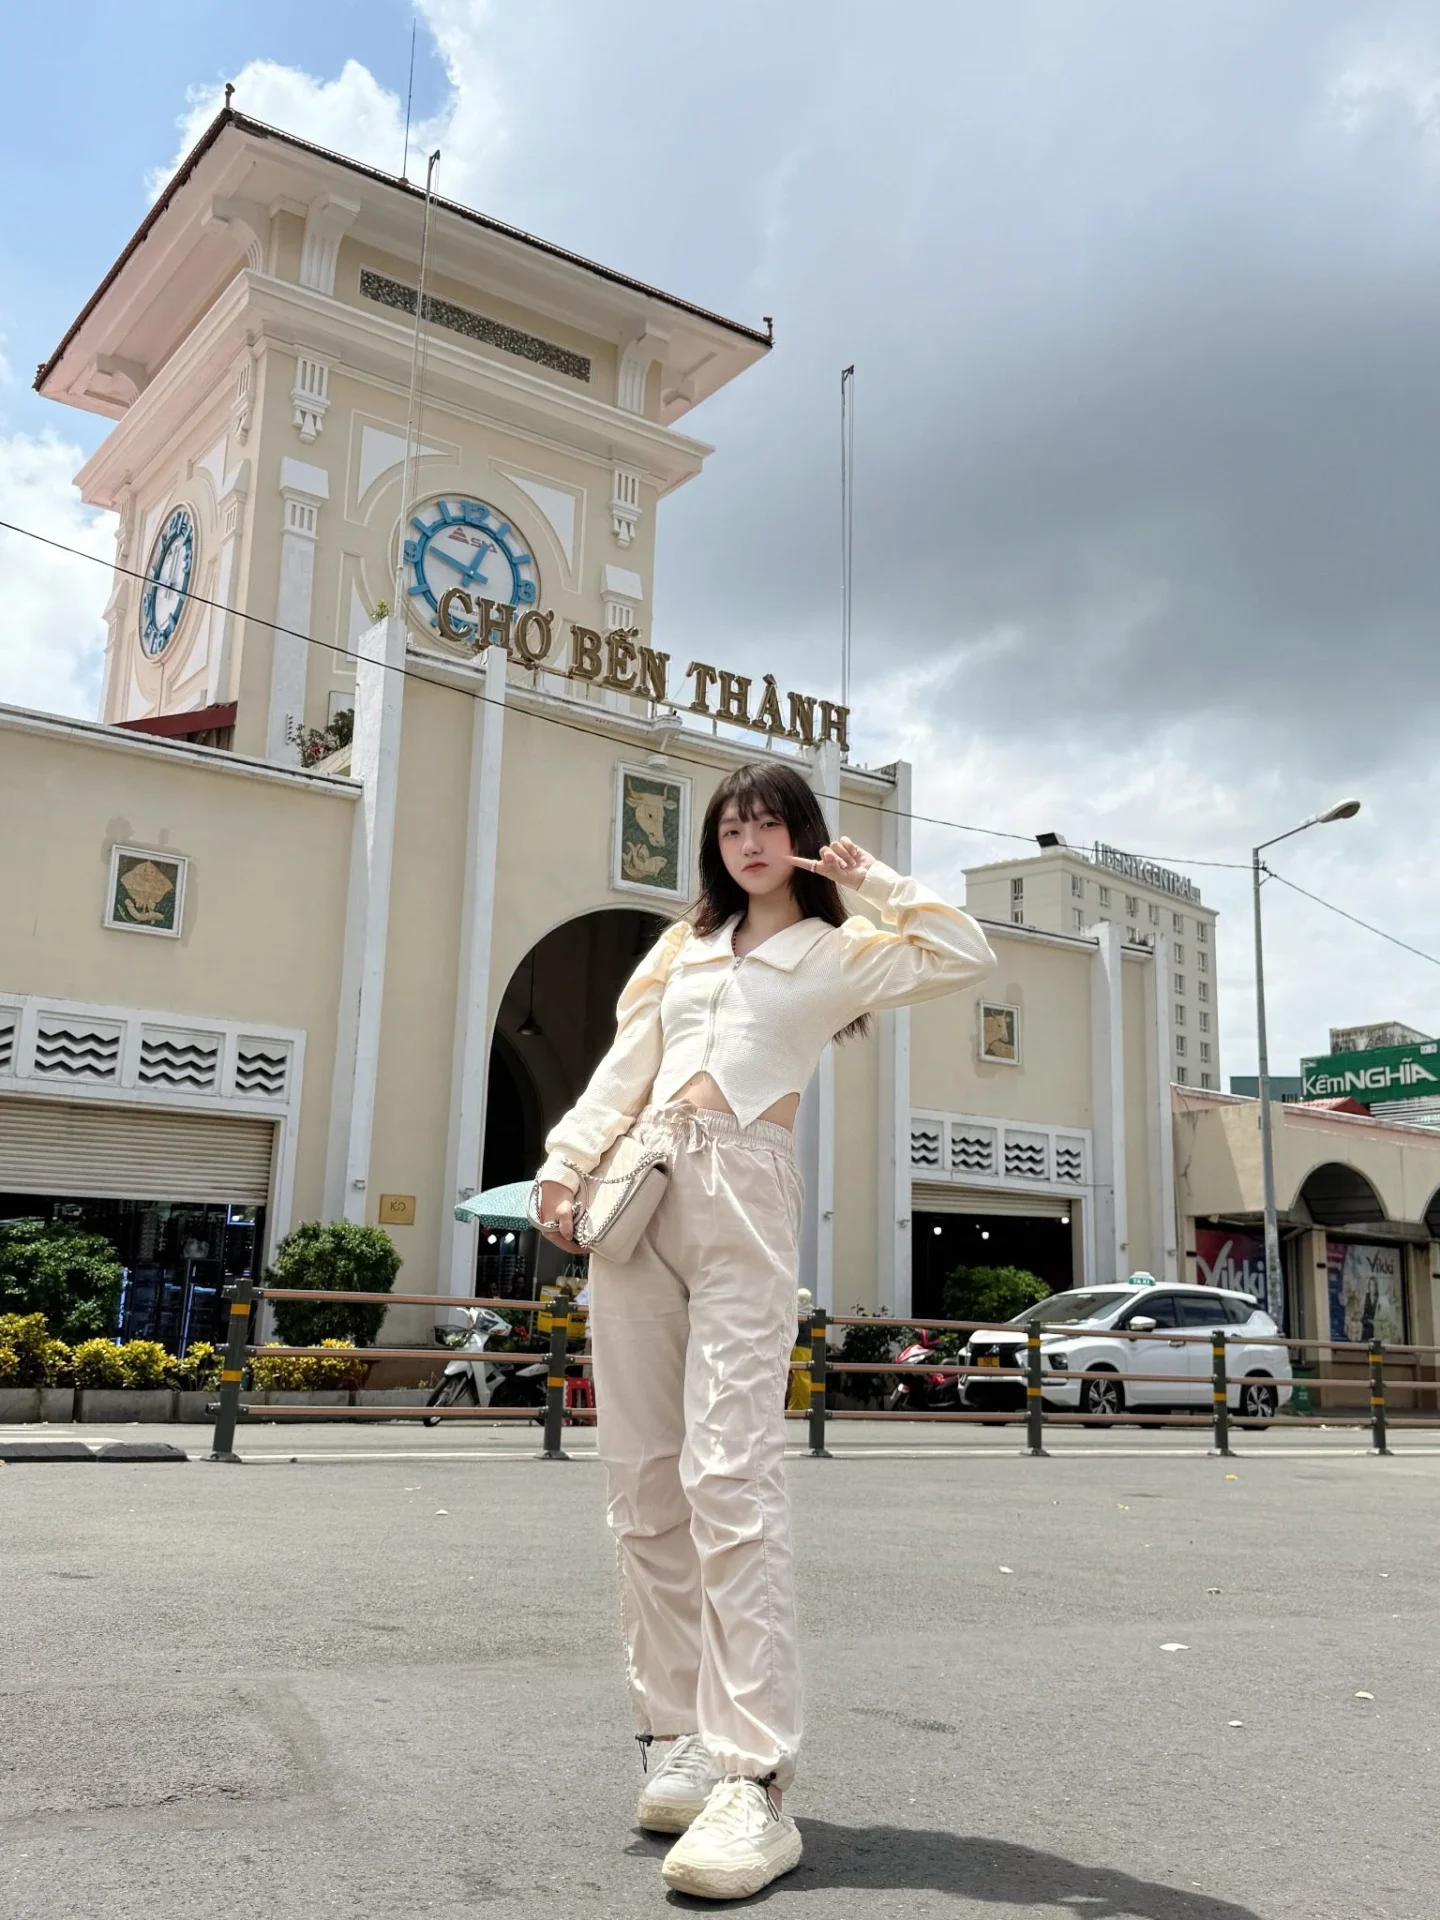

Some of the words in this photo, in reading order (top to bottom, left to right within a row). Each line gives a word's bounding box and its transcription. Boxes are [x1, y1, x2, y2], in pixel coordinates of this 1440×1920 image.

[461, 500, 490, 528] 12
[518, 579, 536, 604] 3
[437, 586, 555, 671] CHỢ
[569, 625, 671, 705] BẾN
[685, 660, 851, 752] THÀNH
[1141, 860, 1194, 902] CENTRAL
[1195, 1240, 1266, 1299] Vikki
